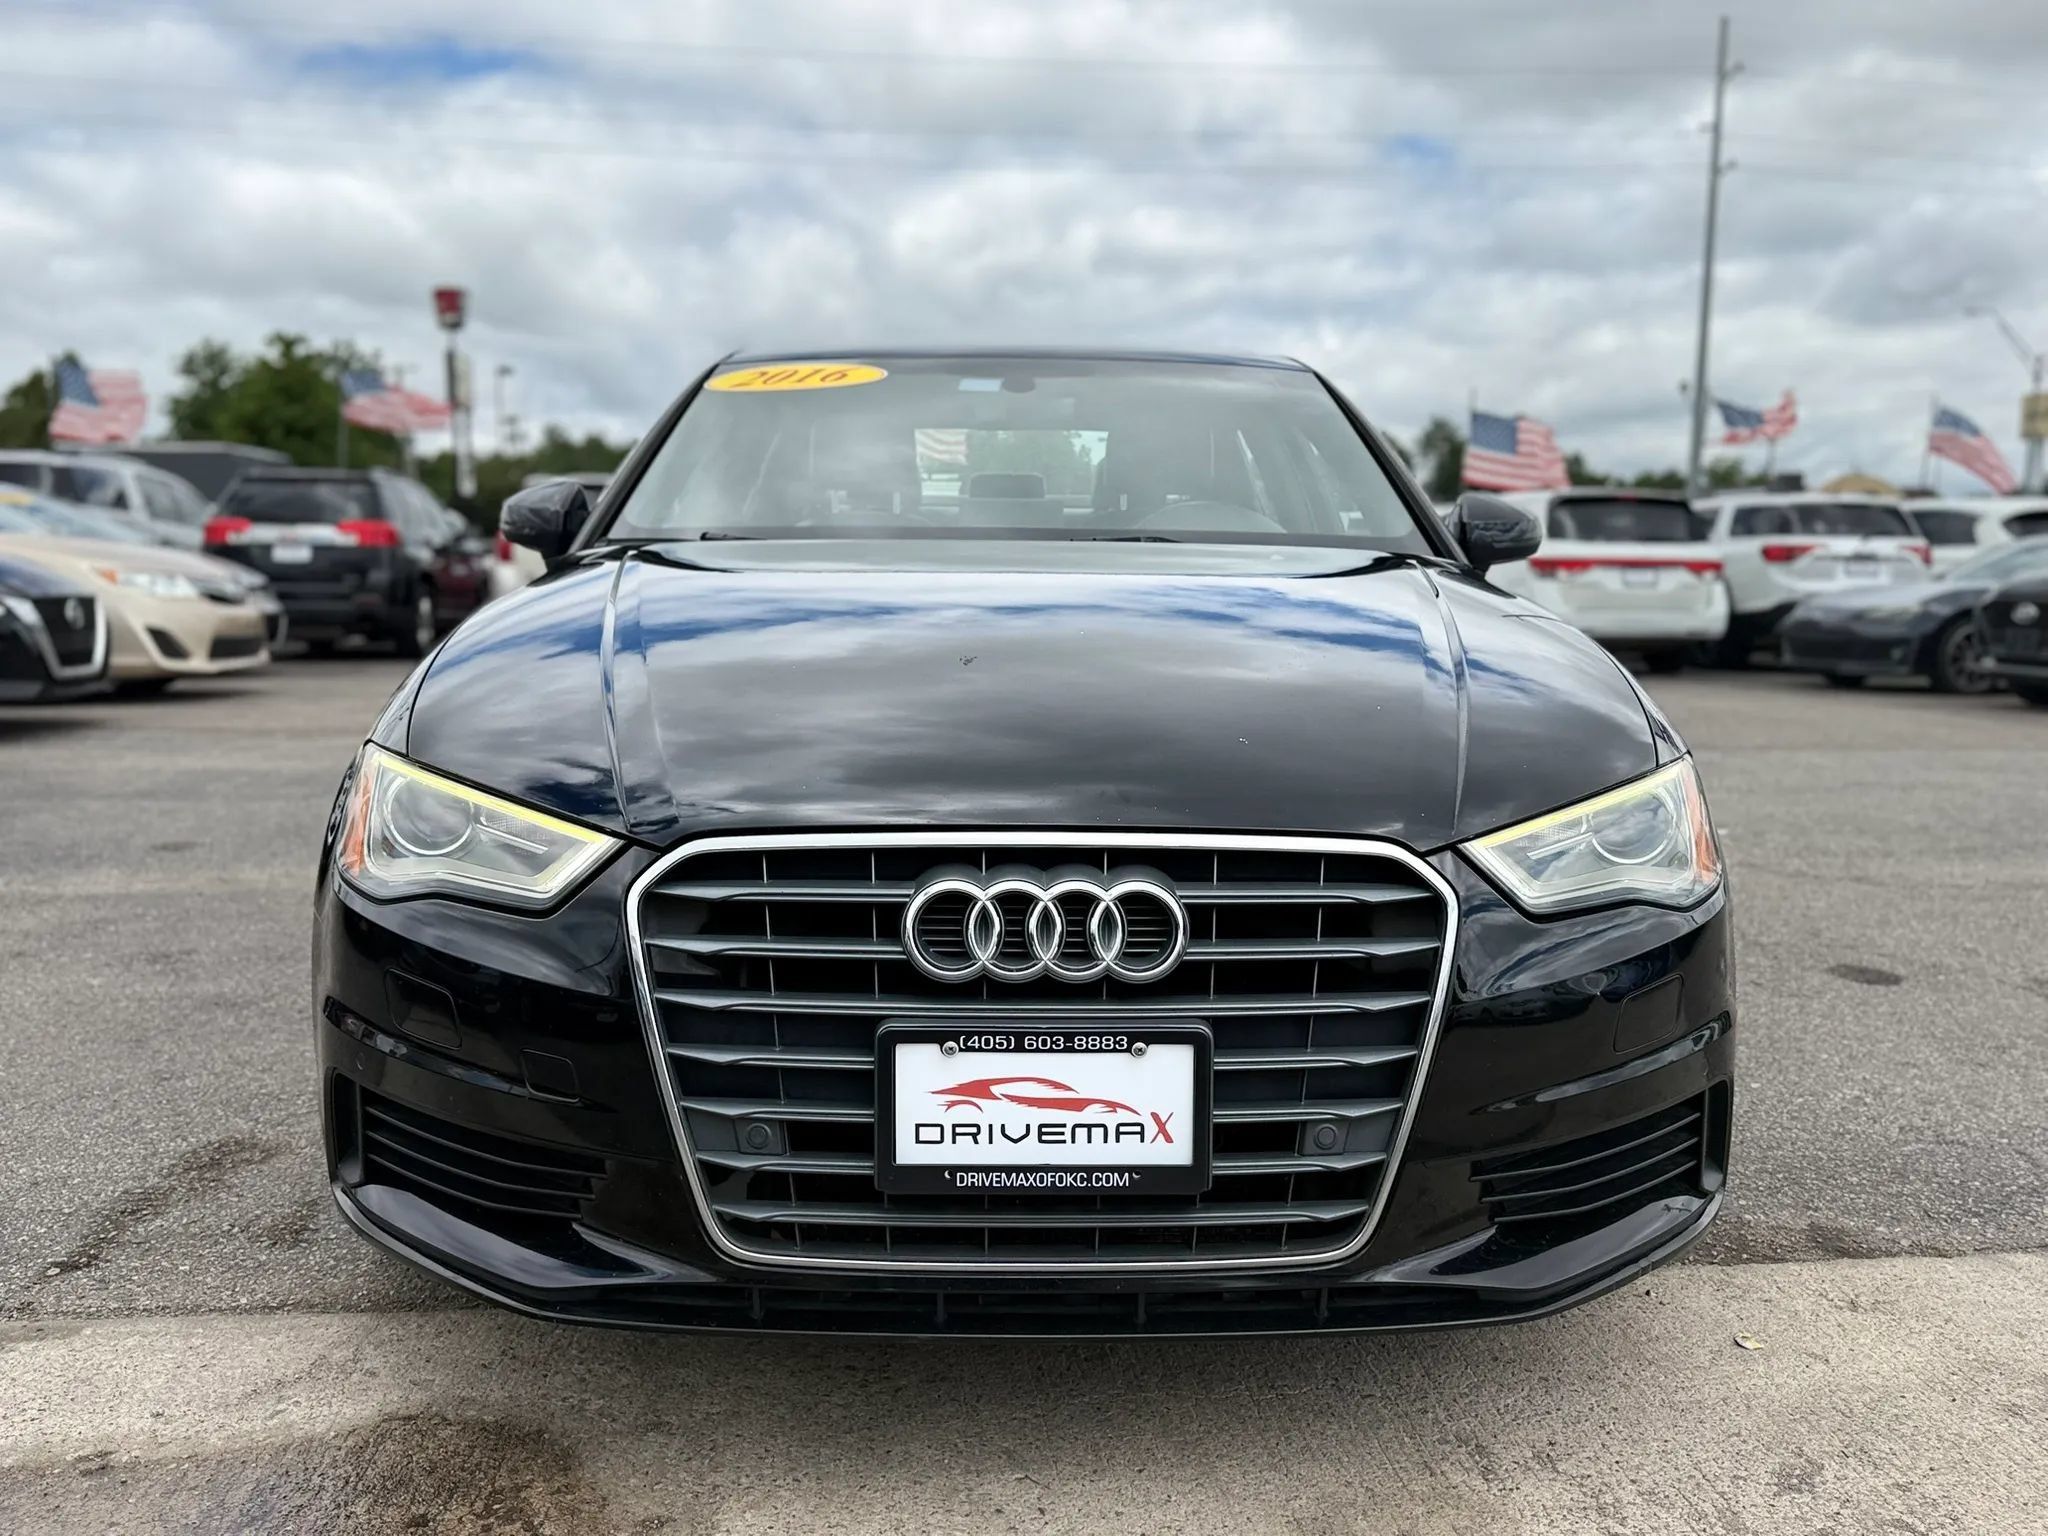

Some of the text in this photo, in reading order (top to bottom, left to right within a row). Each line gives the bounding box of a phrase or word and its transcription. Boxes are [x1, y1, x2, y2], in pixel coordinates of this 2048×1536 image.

[728, 366, 862, 389] 2016
[959, 1035, 1128, 1050] (405) 603-8883
[914, 1111, 1174, 1144] DRIVEMAX
[956, 1172, 1129, 1187] DRIVEMAXOFOKC.COM
